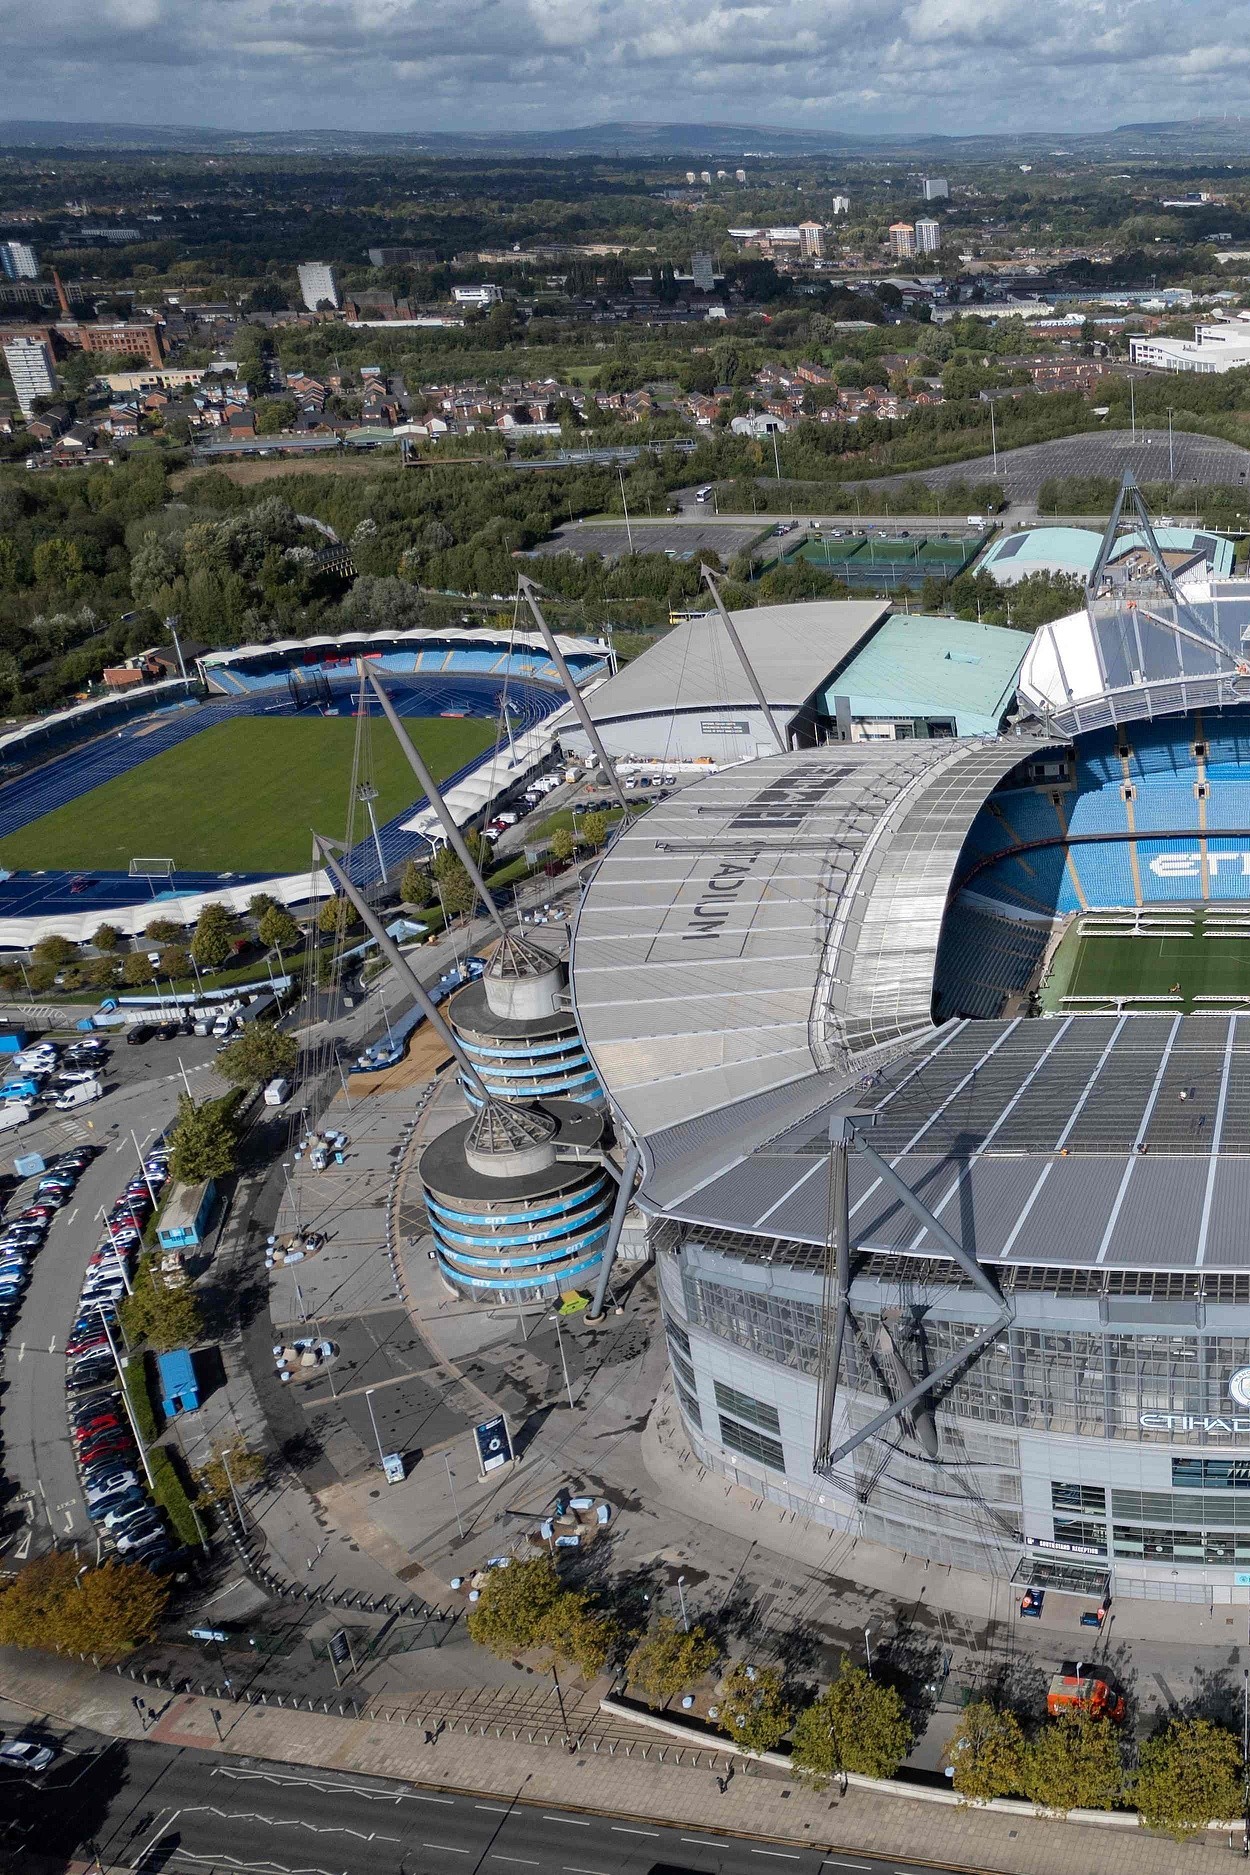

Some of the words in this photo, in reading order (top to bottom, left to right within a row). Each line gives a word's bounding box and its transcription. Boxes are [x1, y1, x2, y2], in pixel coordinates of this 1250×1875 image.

[682, 841, 767, 940] TADIUM
[485, 1216, 507, 1225] CITY
[527, 1231, 549, 1243] CITY
[565, 1241, 585, 1254] CITY
[471, 1279, 491, 1288] CITY
[1071, 1545, 1099, 1555] RECEPTION
